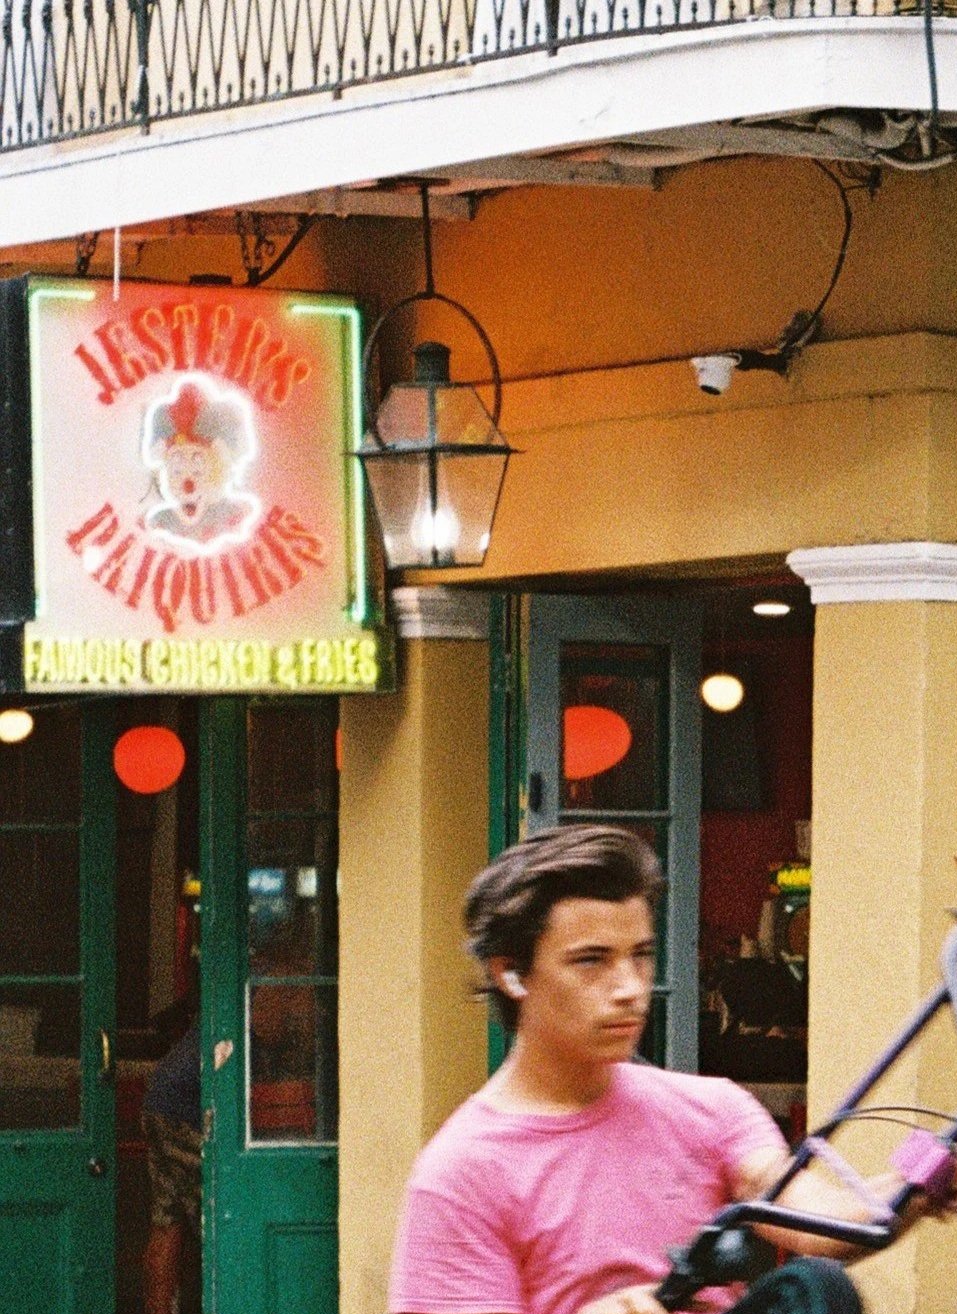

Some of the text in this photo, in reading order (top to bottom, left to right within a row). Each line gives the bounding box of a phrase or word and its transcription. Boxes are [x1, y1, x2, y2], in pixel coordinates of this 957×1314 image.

[74, 303, 312, 411] JESTERS
[65, 502, 325, 633] DAIQUIRIS
[25, 638, 377, 689] FAMOUS CHICKEN & FRIES
